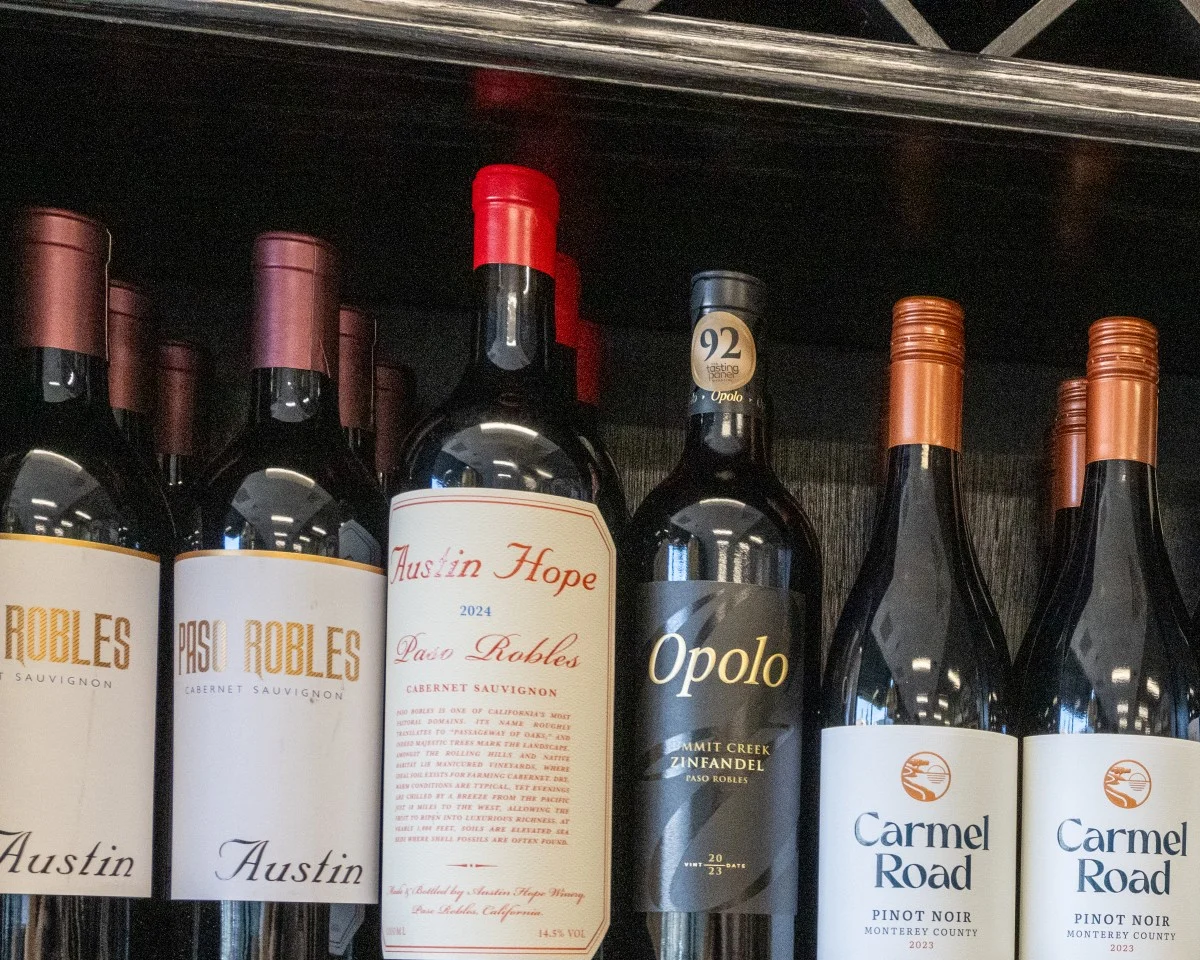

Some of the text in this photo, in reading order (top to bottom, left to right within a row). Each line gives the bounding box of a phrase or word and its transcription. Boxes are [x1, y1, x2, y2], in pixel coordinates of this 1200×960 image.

[700, 327, 741, 361] 92
[706, 363, 739, 374] tasting
[709, 371, 735, 381] panel
[711, 391, 743, 403] Opolo
[390, 542, 597, 597] Austin Hope
[459, 605, 492, 617] 2024
[4, 604, 131, 670] ROBLES
[178, 619, 361, 682] PASO ROBLES
[394, 632, 581, 668] Paso Robles
[649, 632, 789, 698] Opolo
[14, 672, 113, 689] SAUVIGNON
[184, 684, 344, 701] CABERNET SAUVIGNON
[406, 683, 557, 697] CABERNET SAUVIGNON
[677, 742, 770, 755] MMIT CREEK
[670, 756, 764, 771] ZINFANDEL
[713, 775, 748, 784] ROBLES
[854, 811, 990, 850] Carmel
[1057, 818, 1188, 857] Carmel
[0, 830, 134, 878] Austin
[708, 853, 723, 862] 20
[214, 838, 364, 885] Austin
[708, 866, 723, 876] 23
[874, 853, 972, 891] Road
[1077, 858, 1171, 896] Road
[872, 909, 972, 923] PINOT NOIR
[1074, 914, 1170, 927] PINOT NOIR
[538, 930, 585, 938] 14.5% VOL
[864, 926, 978, 937] MONTEREY COUNTY
[1066, 930, 1176, 941] MONTEREY COUNTY
[909, 941, 934, 949] 2023
[1110, 943, 1134, 952] 2023
